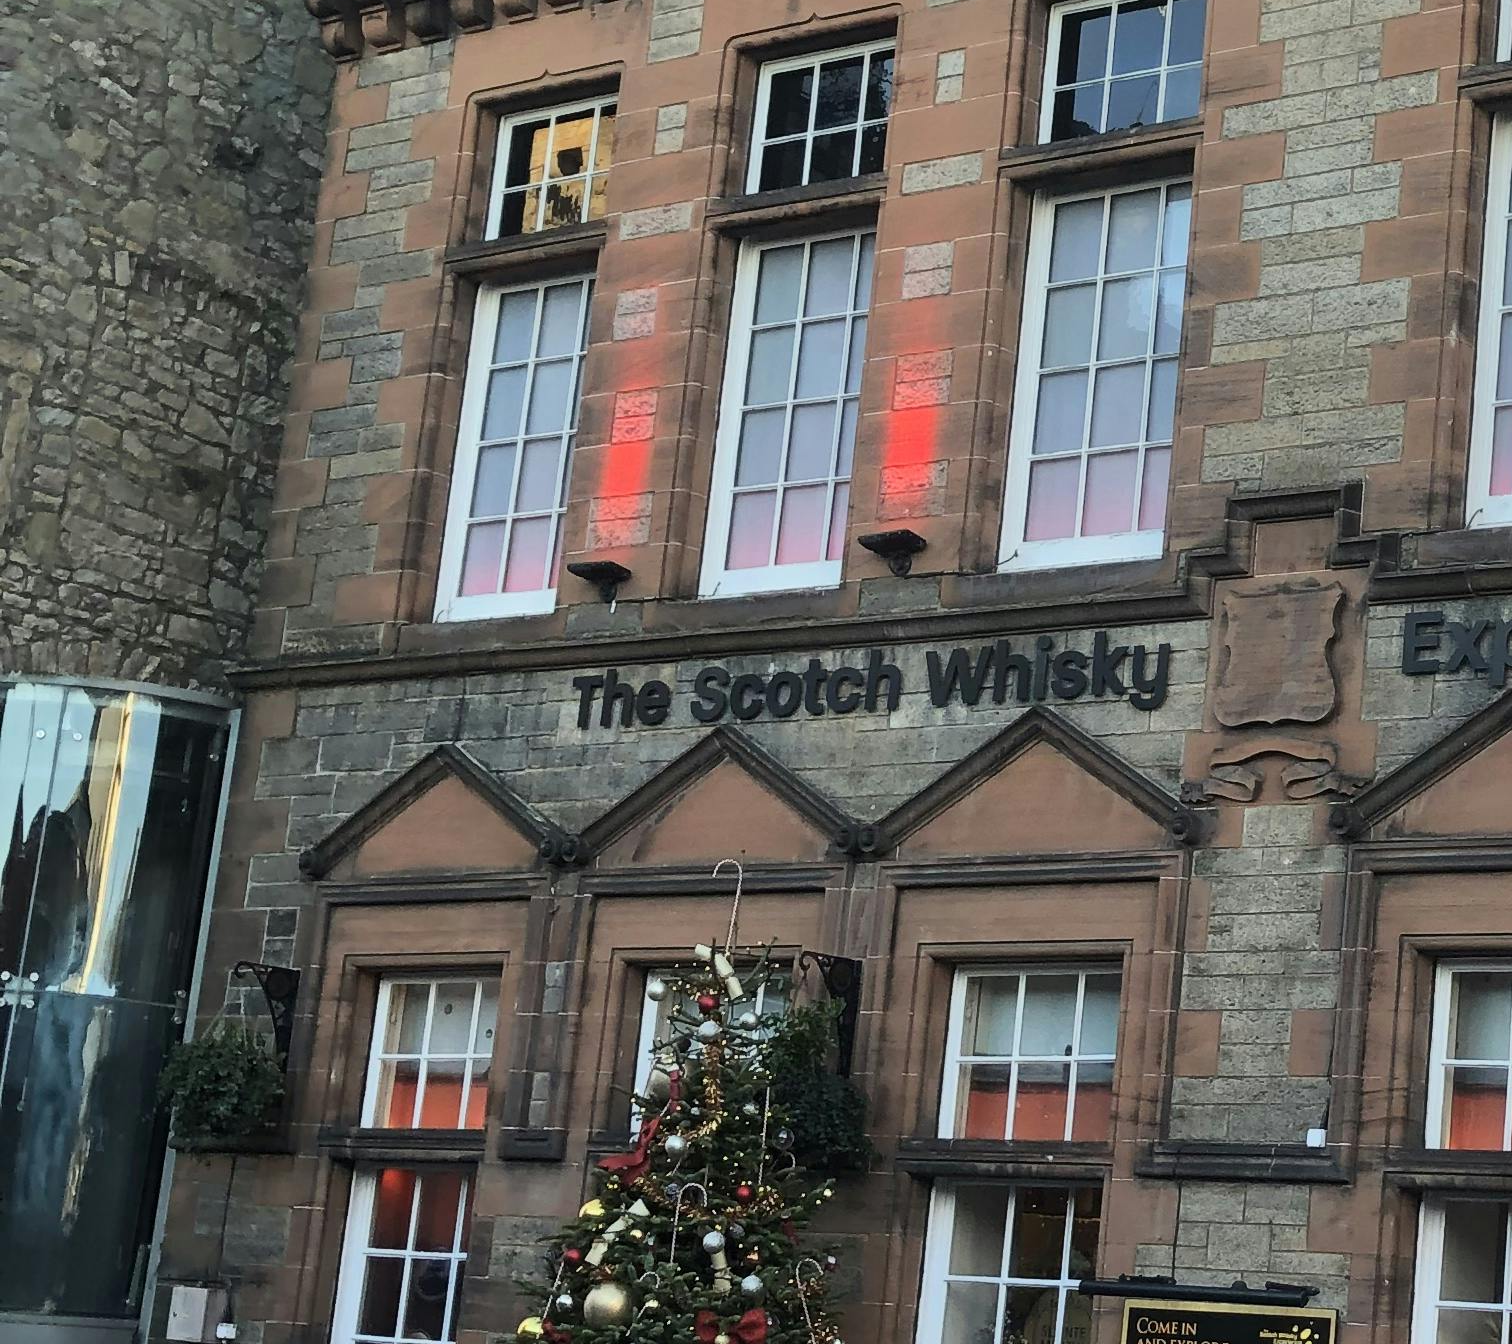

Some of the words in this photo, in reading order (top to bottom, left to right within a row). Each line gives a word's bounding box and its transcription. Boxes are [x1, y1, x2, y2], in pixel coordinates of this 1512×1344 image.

[573, 668, 671, 730] The
[690, 649, 902, 725] Scotch
[926, 630, 1172, 711] Whisky
[1136, 1317, 1178, 1335] COME
[1181, 1322, 1197, 1336] IN
